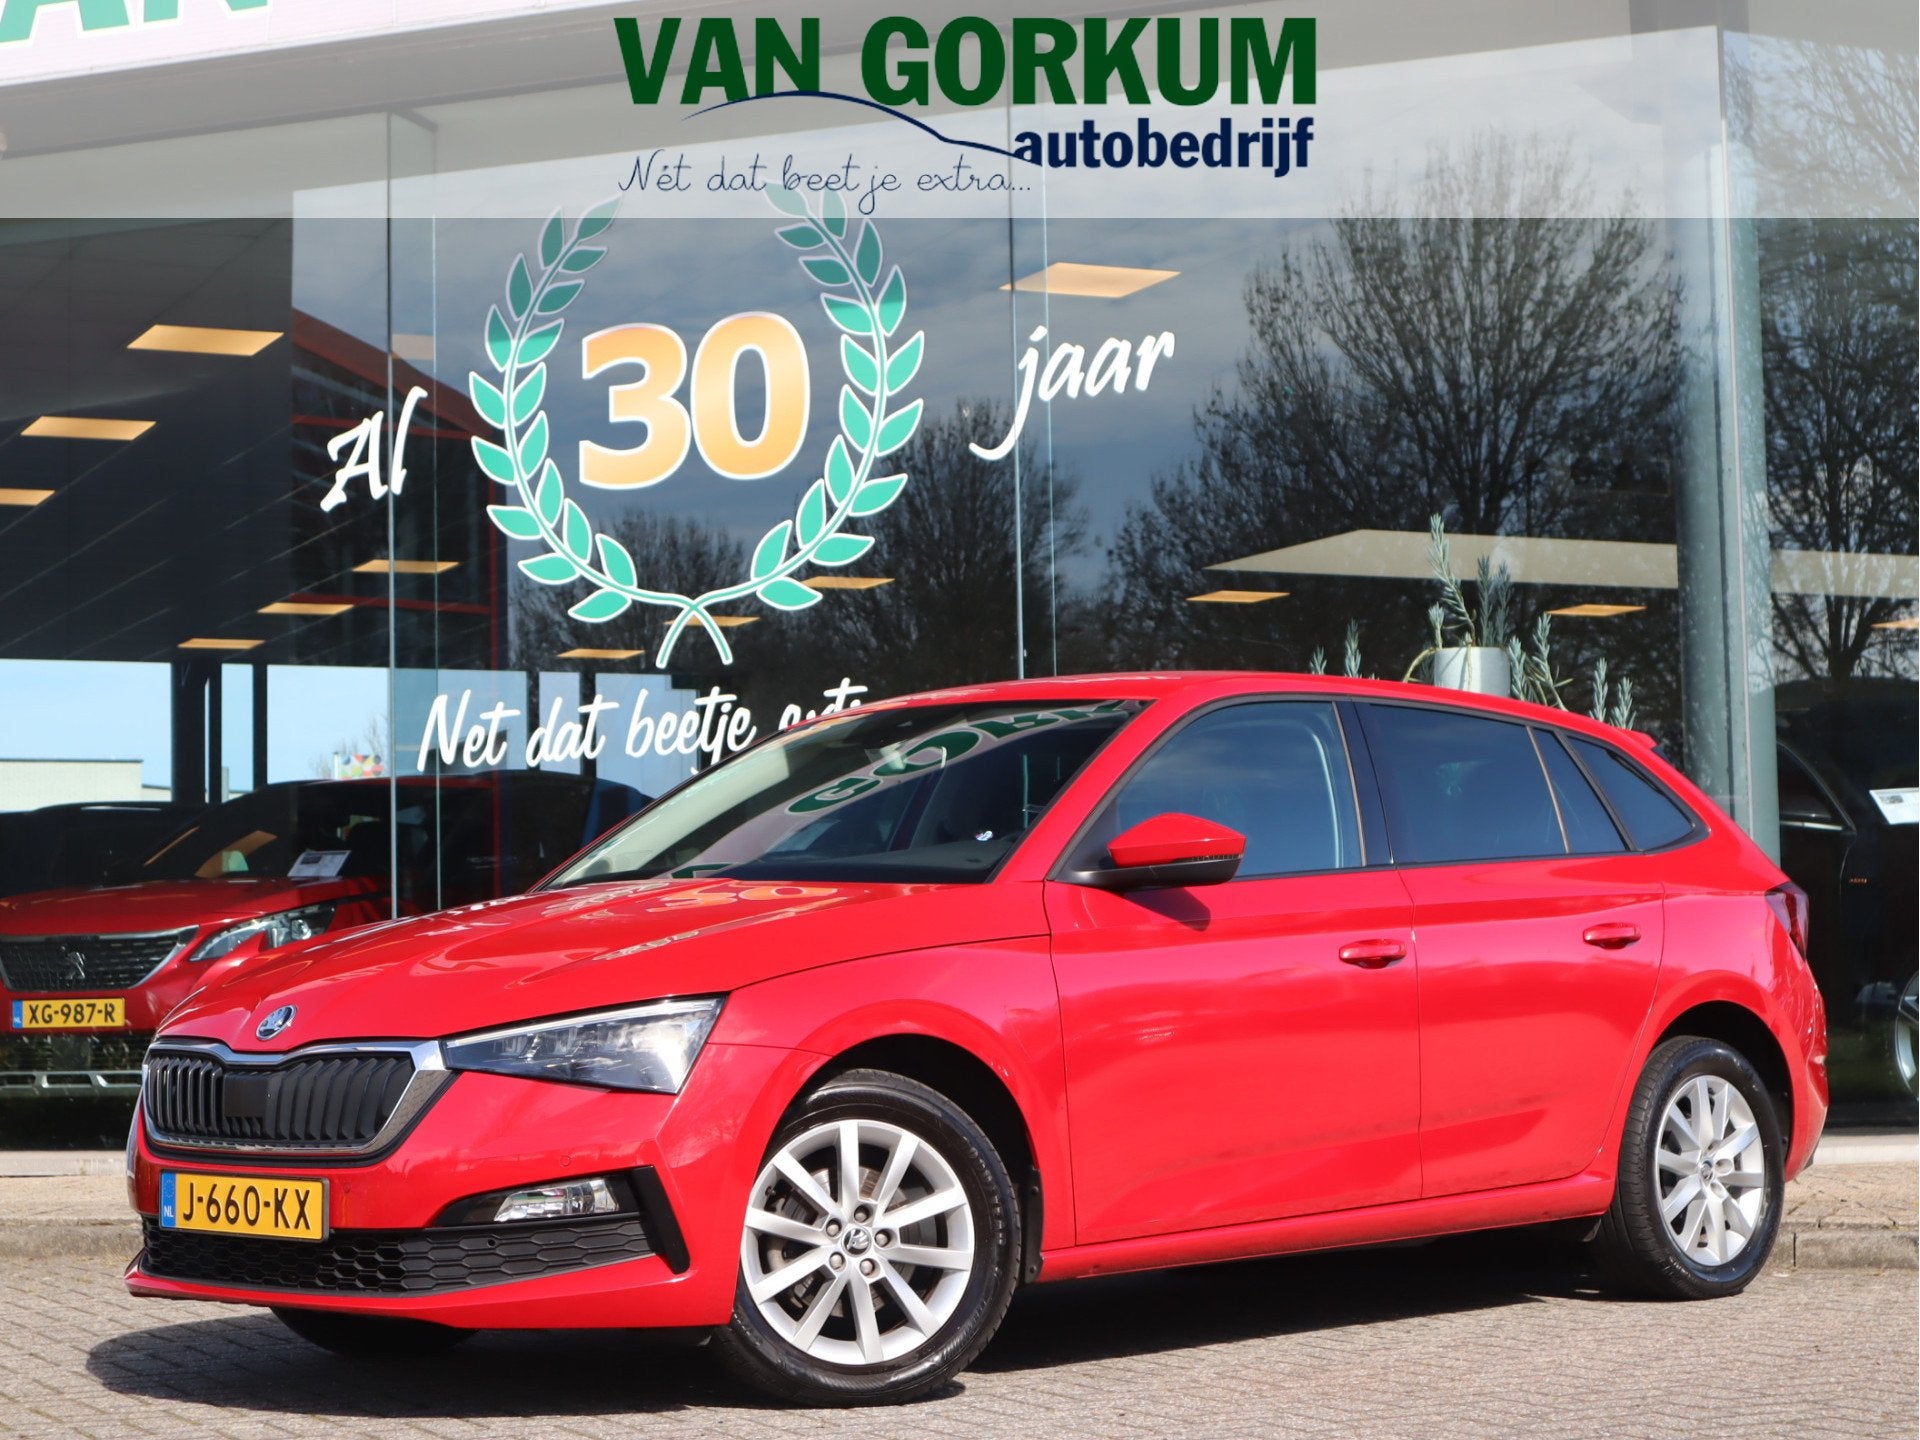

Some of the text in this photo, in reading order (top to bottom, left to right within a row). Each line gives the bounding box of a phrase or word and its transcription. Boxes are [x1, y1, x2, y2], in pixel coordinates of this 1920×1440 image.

[320, 311, 1175, 512] Al 30 jaar
[417, 688, 520, 772] Net
[526, 697, 619, 767] dat
[626, 686, 756, 774] beetje
[28, 1003, 116, 1025] XG-987-R
[163, 1182, 311, 1230] NL J-660-KX
